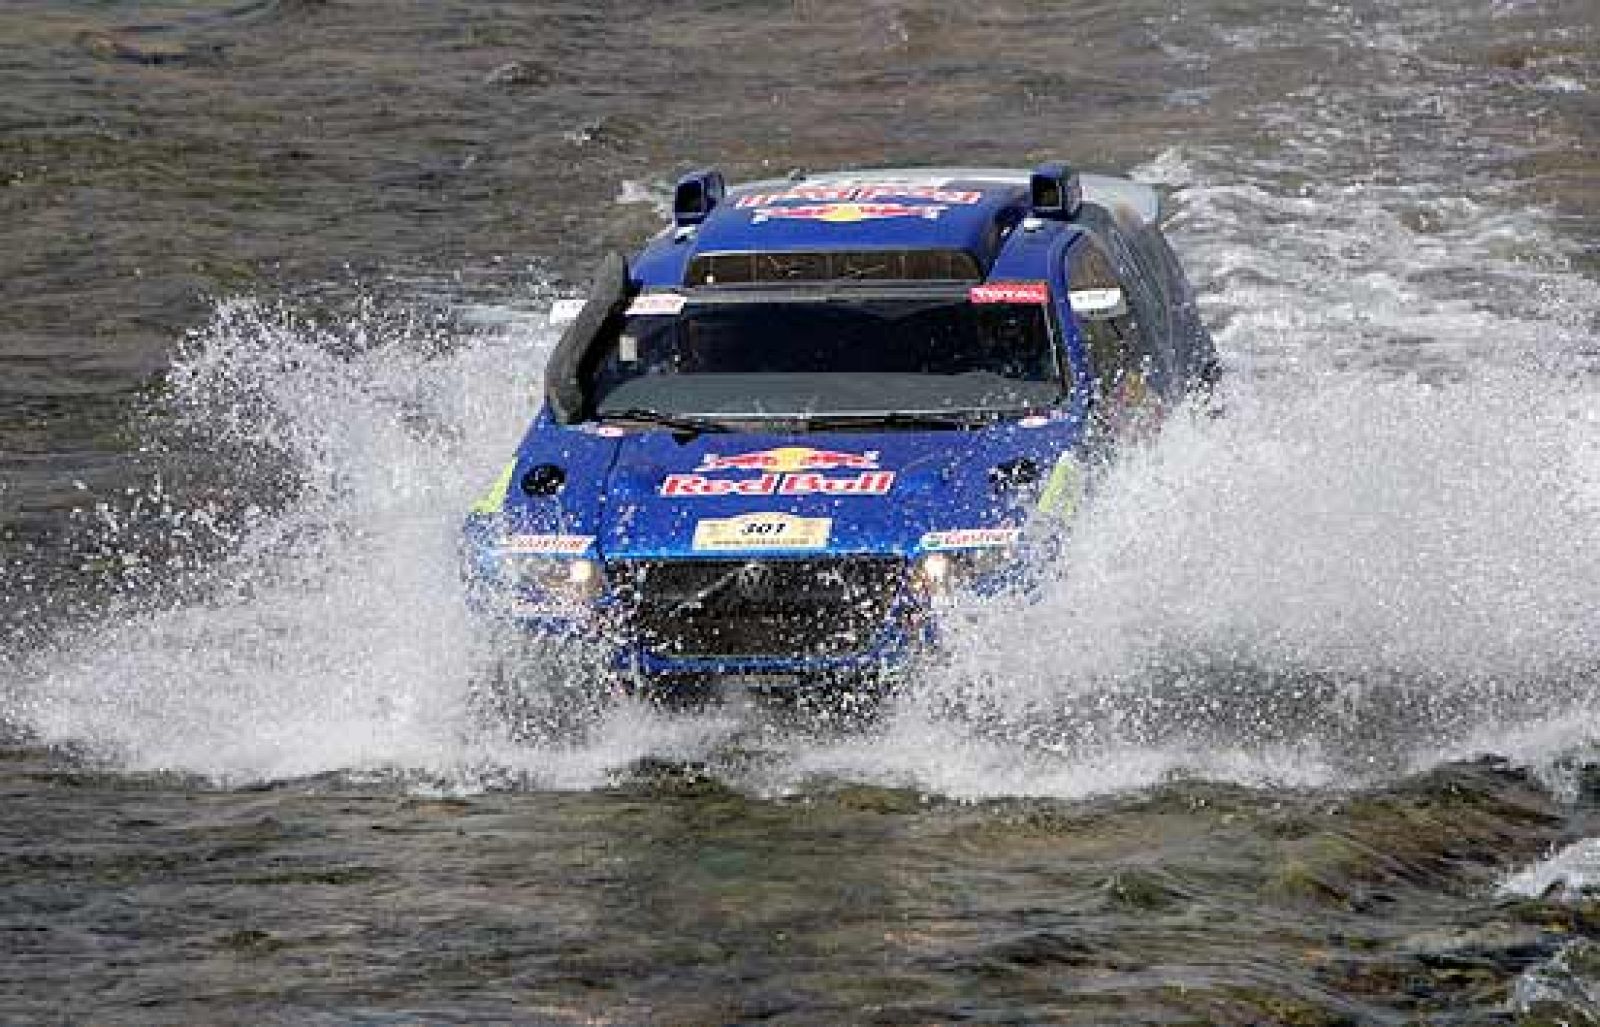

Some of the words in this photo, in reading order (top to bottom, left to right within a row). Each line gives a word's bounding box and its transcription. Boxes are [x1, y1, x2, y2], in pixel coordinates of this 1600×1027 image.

[971, 286, 1045, 301] TOTAL
[661, 474, 779, 496] Red
[780, 471, 896, 496] Bull
[740, 522, 786, 535] 301
[943, 529, 1015, 546] Castrol
